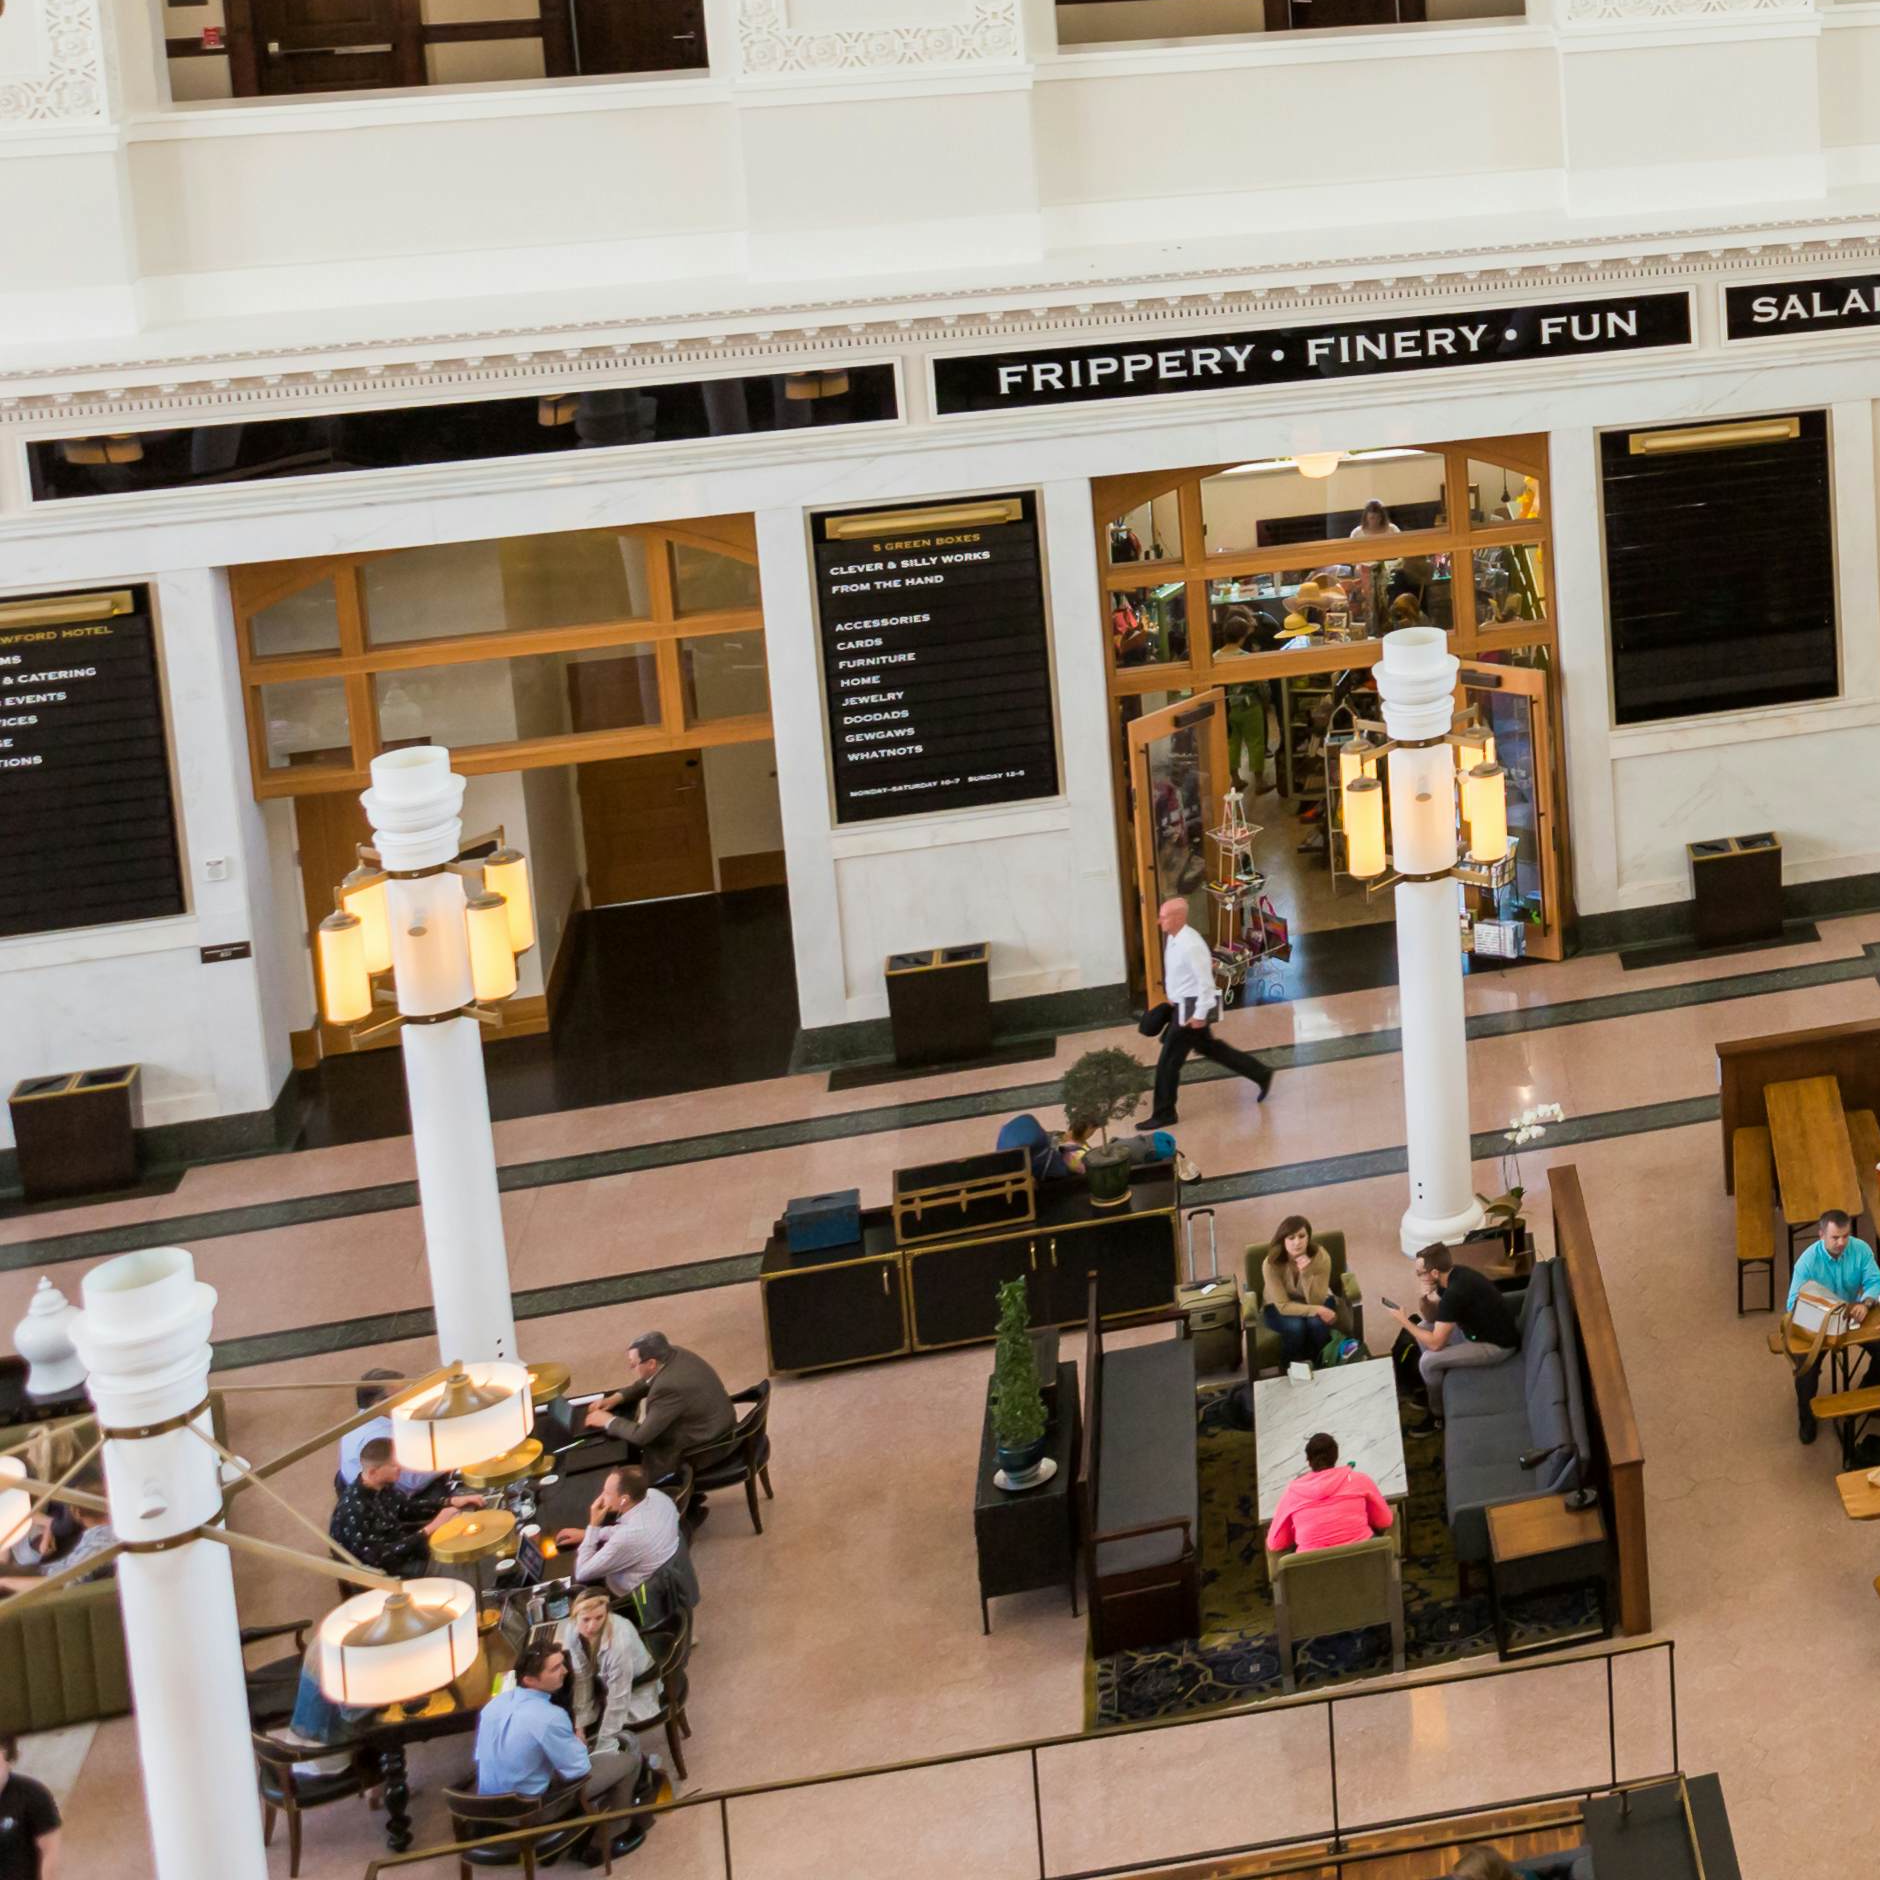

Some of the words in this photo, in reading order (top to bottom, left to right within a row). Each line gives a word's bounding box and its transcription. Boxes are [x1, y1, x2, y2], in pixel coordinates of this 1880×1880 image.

[998, 344, 1254, 395] FRIPPERY
[1306, 323, 1488, 367] FINERY
[1541, 310, 1641, 349] FUN
[885, 539, 931, 550] GREEN
[936, 534, 980, 545] BOXES
[830, 563, 883, 575] CLEVER
[901, 557, 937, 568] SILLY
[941, 551, 990, 563] WORKS
[832, 583, 870, 593] FROM
[874, 580, 901, 589] THE
[905, 575, 944, 586] HAND
[836, 614, 930, 631] ACCESSORIES
[0, 632, 57, 644] WFORD
[62, 626, 112, 638] HOTEL
[837, 638, 883, 650] CARDS
[0, 656, 21, 665] MS
[839, 653, 915, 669] FURNITURE
[3, 677, 13, 685] &
[17, 668, 96, 683] CATERING
[841, 676, 880, 687] HOME
[5, 692, 66, 706] EVENTS
[842, 692, 903, 706] JEWELRY
[844, 710, 909, 724] DOODADS
[845, 728, 915, 742] GEWGAWS
[848, 745, 923, 761] WHATNOTS
[968, 773, 1003, 782] SUNDAY
